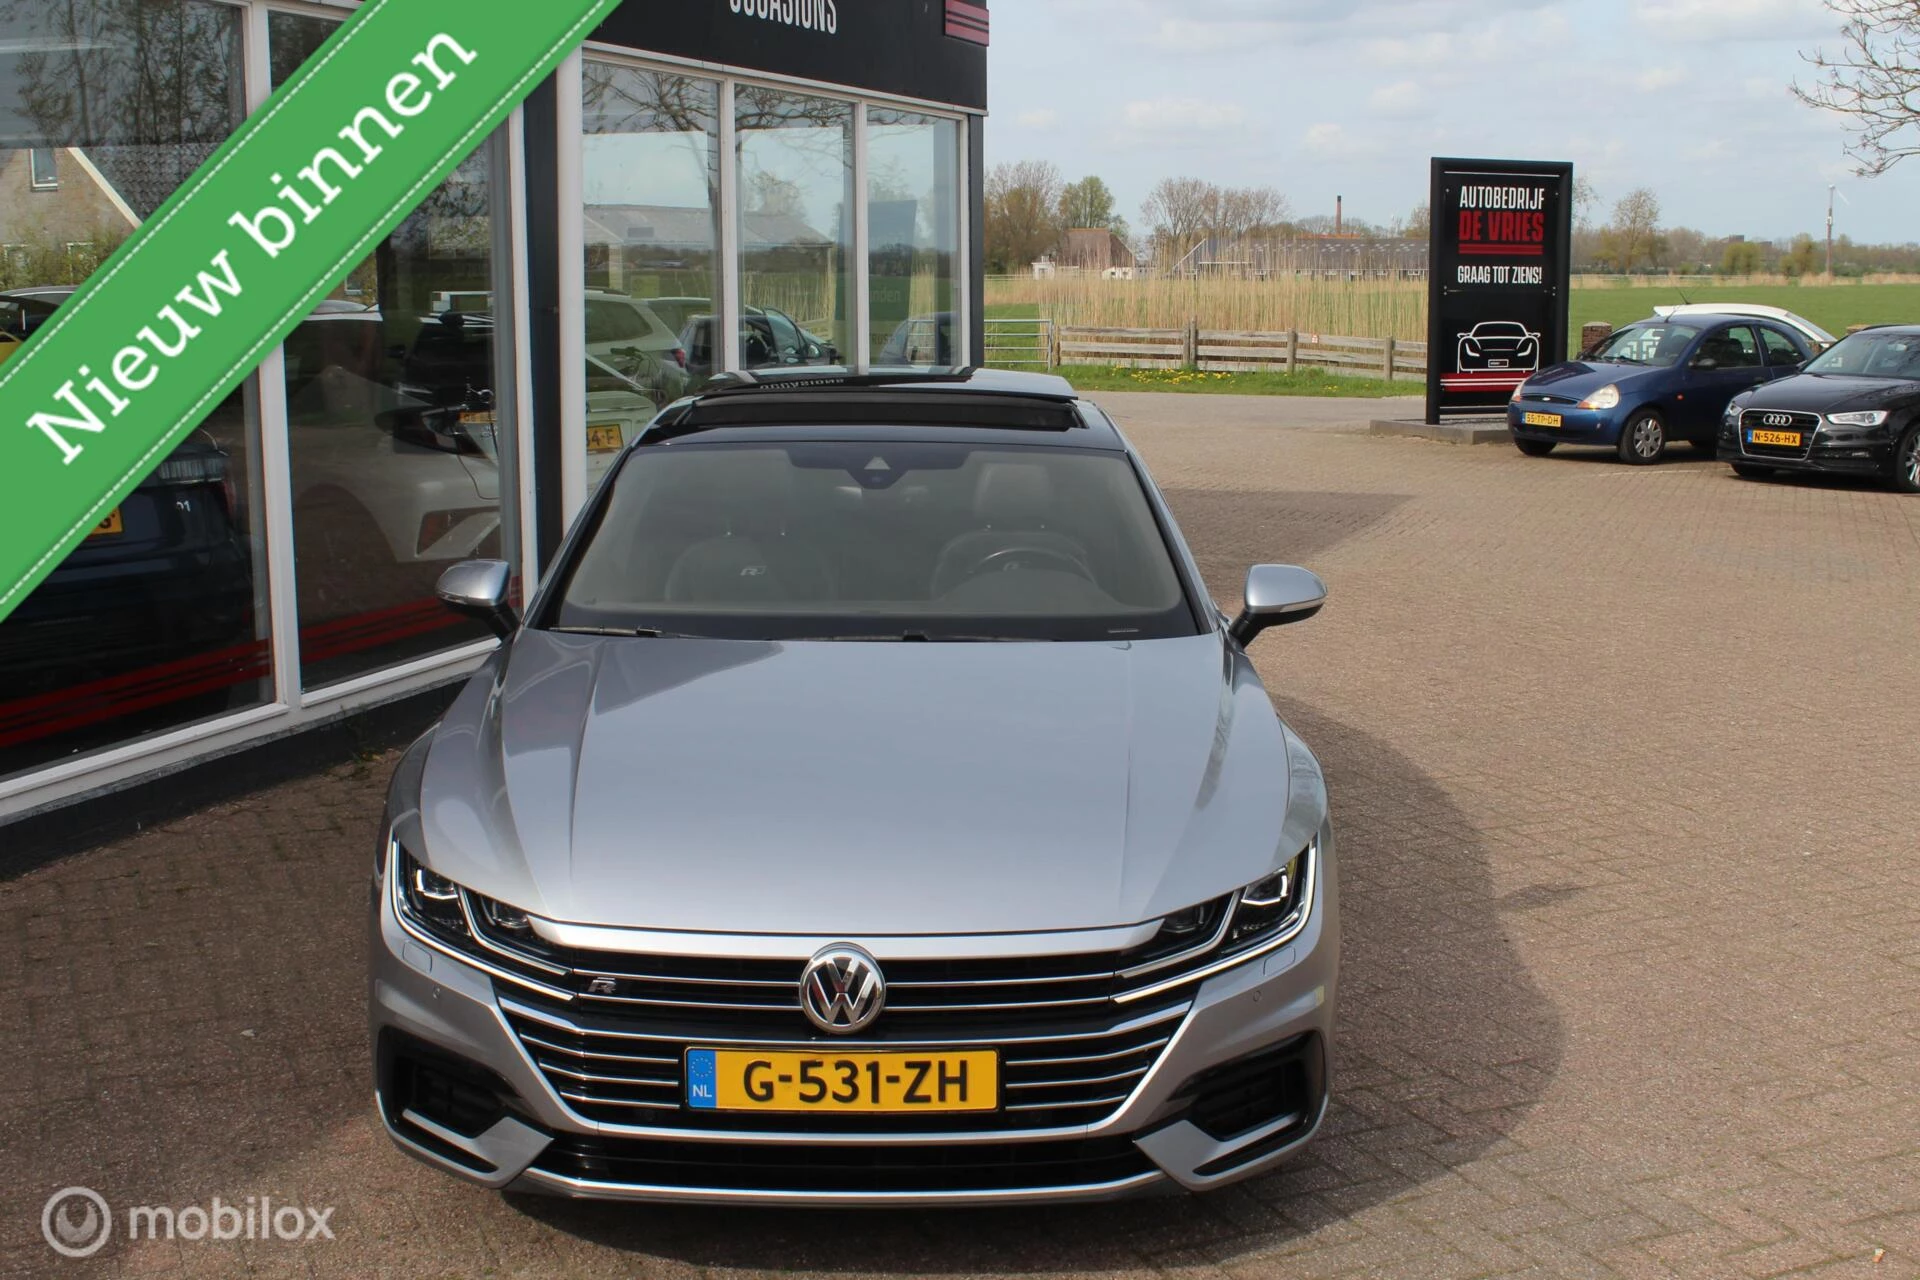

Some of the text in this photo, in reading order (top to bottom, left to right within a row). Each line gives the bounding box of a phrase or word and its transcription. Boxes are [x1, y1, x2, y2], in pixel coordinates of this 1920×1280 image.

[729, 0, 837, 34] ASIONS
[1459, 185, 1545, 210] AUTOBEDRIJF
[1458, 210, 1545, 242] DE VRIES
[1457, 265, 1542, 284] GRAAG TOT ZIENS!
[1754, 431, 1798, 445] N-526-HX
[692, 1084, 713, 1098] NL
[743, 1060, 968, 1104] G-531-ZH
